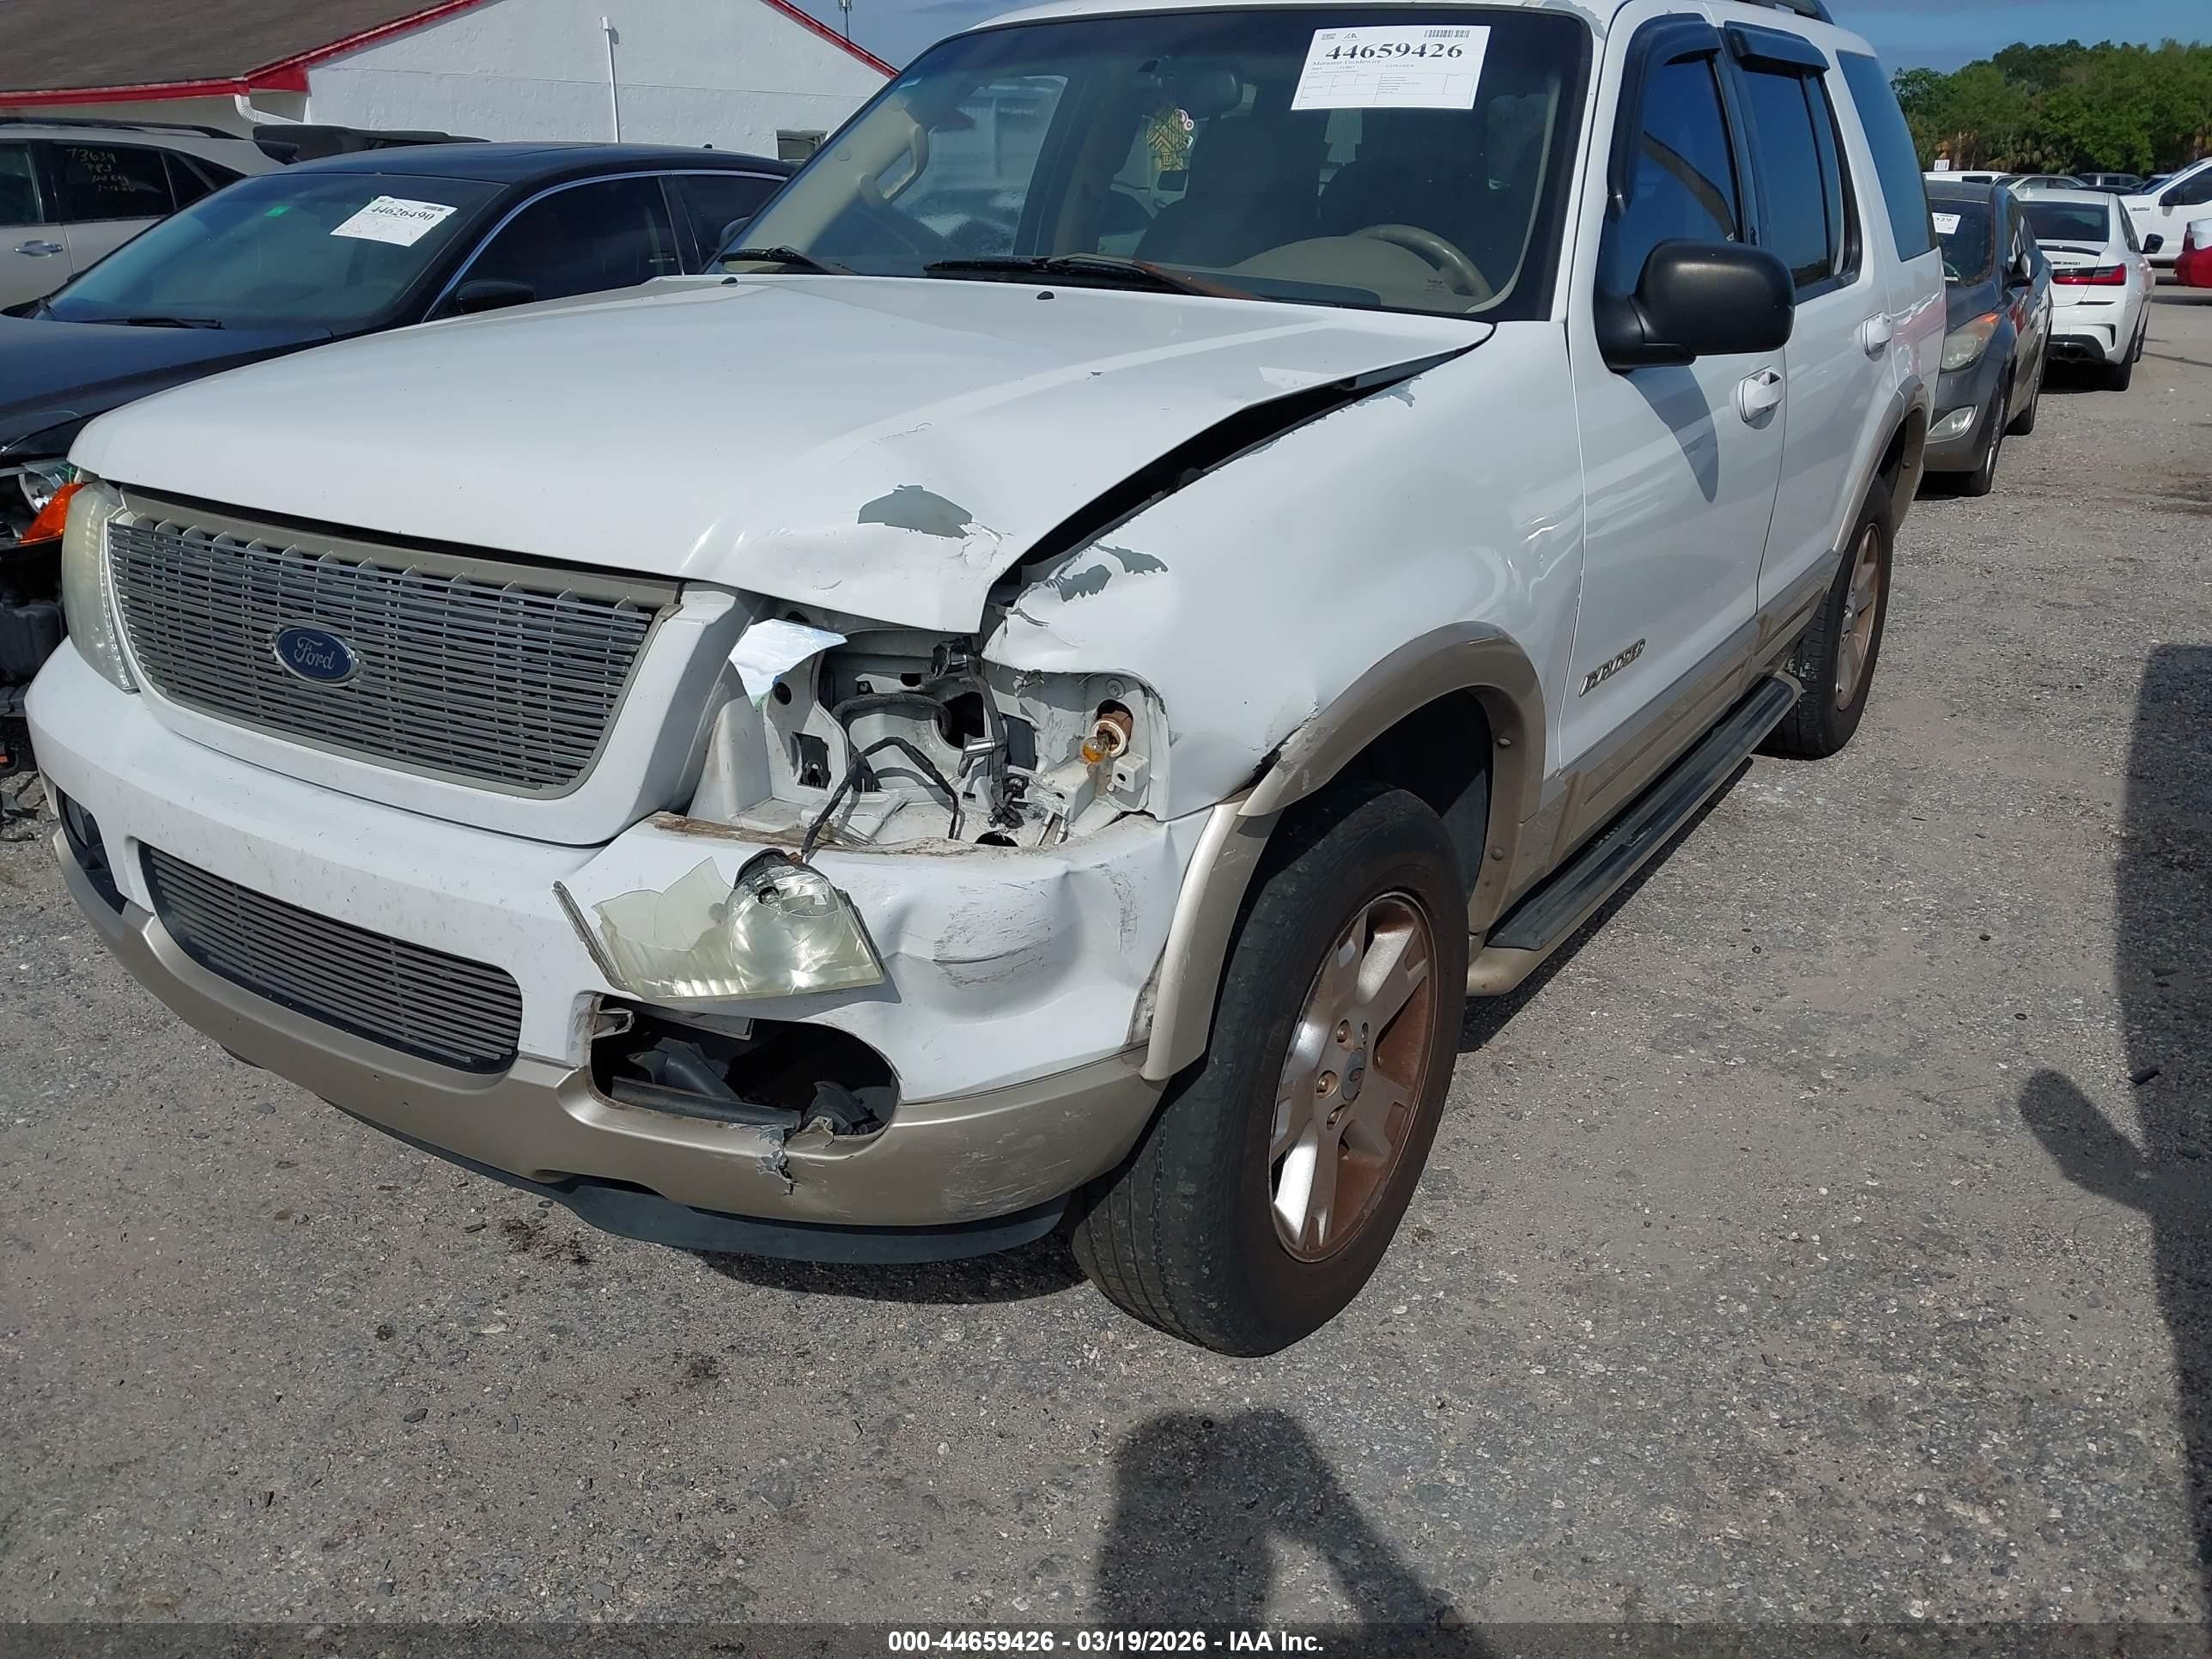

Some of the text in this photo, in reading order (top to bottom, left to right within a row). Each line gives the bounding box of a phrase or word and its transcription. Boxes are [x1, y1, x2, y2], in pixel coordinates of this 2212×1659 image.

[1325, 42, 1463, 60] 44659426
[370, 205, 435, 221] 44626490
[294, 636, 336, 671] Ford
